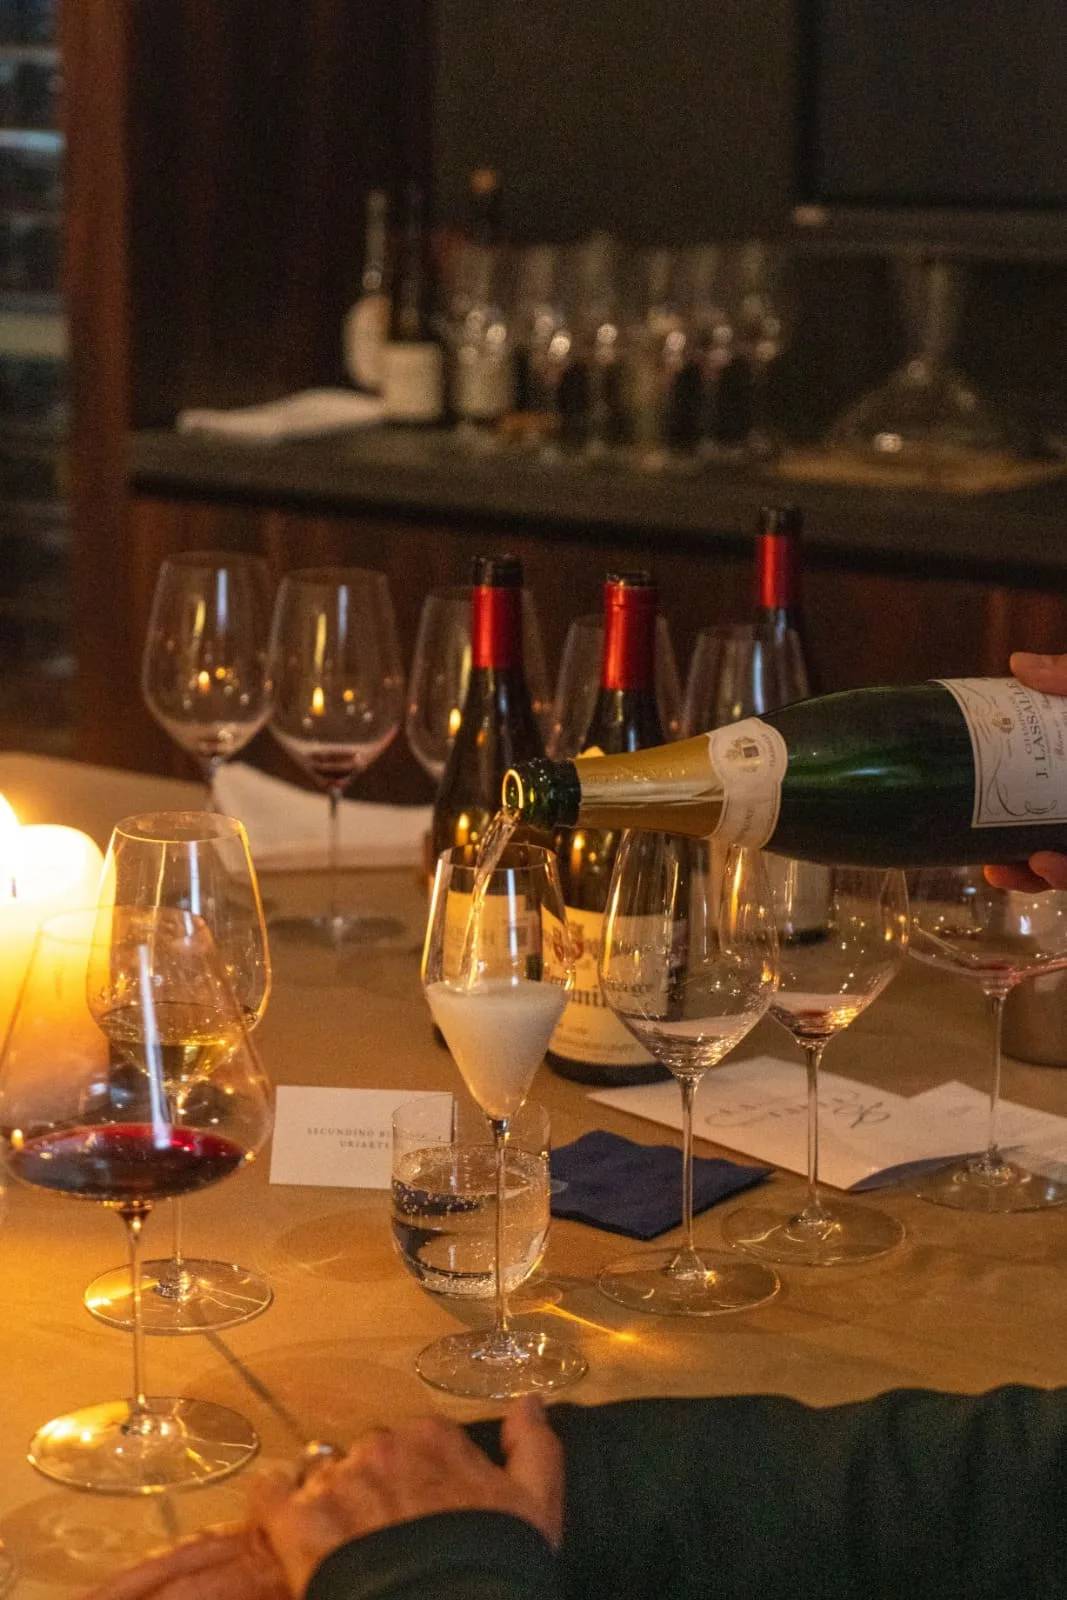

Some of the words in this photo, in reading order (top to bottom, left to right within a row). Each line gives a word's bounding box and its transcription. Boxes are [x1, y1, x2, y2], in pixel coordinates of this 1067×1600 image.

[1006, 681, 1046, 761] LASSALLE
[1035, 767, 1049, 779] J.
[307, 1127, 375, 1137] SECUNDINO
